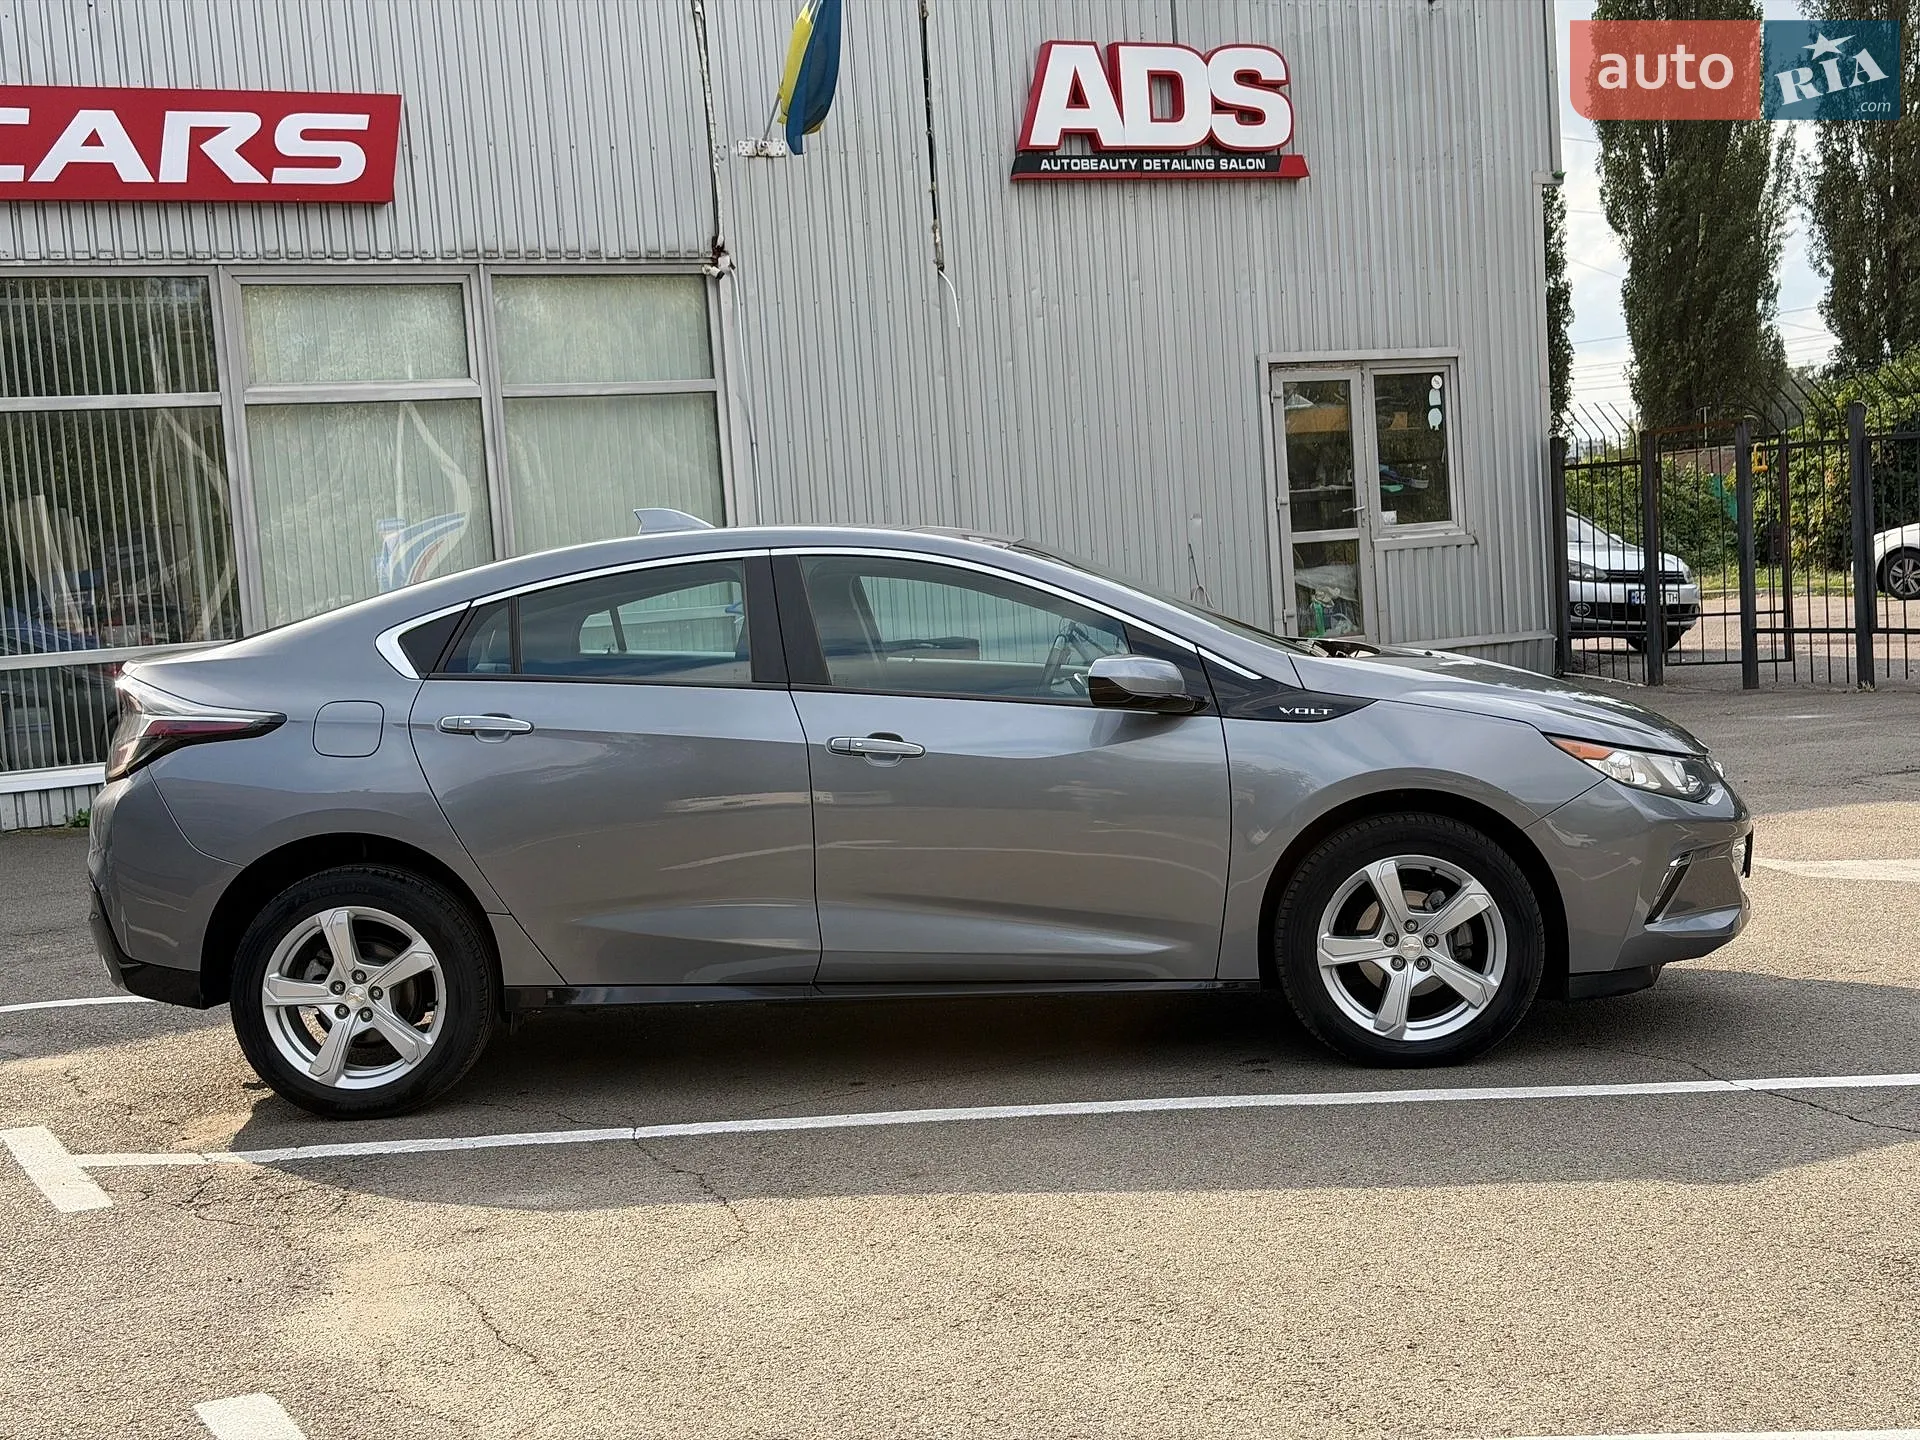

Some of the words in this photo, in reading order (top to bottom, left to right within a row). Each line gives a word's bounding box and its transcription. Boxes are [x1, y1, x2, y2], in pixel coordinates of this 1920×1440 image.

[1022, 42, 1295, 149] ADS
[1040, 158, 1137, 171] AUTOBEAUTY
[1143, 158, 1215, 171] DETAILING
[1219, 158, 1266, 170] SALON
[1278, 705, 1333, 715] VOLT
